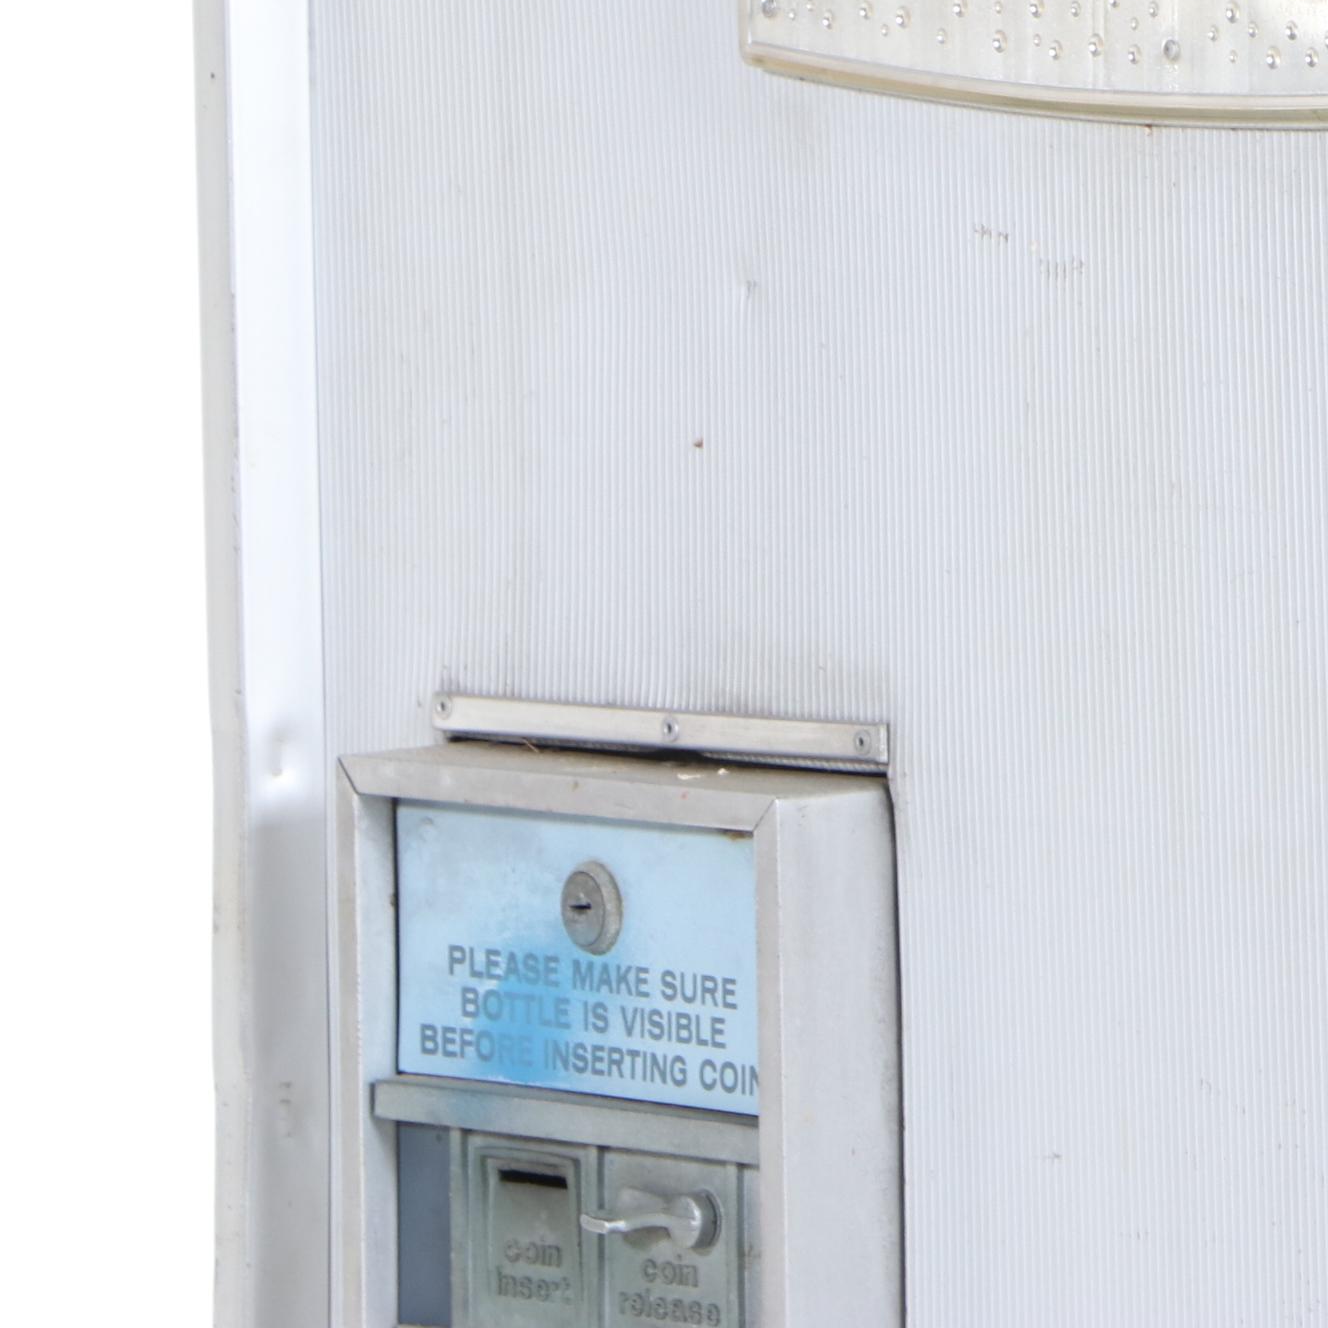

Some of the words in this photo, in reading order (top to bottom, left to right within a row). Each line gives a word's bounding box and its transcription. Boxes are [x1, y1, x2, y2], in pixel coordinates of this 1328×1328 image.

[447, 944, 561, 988] PLEASE
[571, 958, 651, 999] MAKE
[660, 970, 740, 1011] SURE
[460, 986, 572, 1031] BOTTLE
[582, 1001, 611, 1035] IS
[620, 1005, 728, 1050] VISIBLE
[419, 1024, 534, 1068] BEFORE
[543, 1039, 689, 1089] INSERTING
[503, 1236, 563, 1269] coin
[641, 1253, 700, 1289] coin
